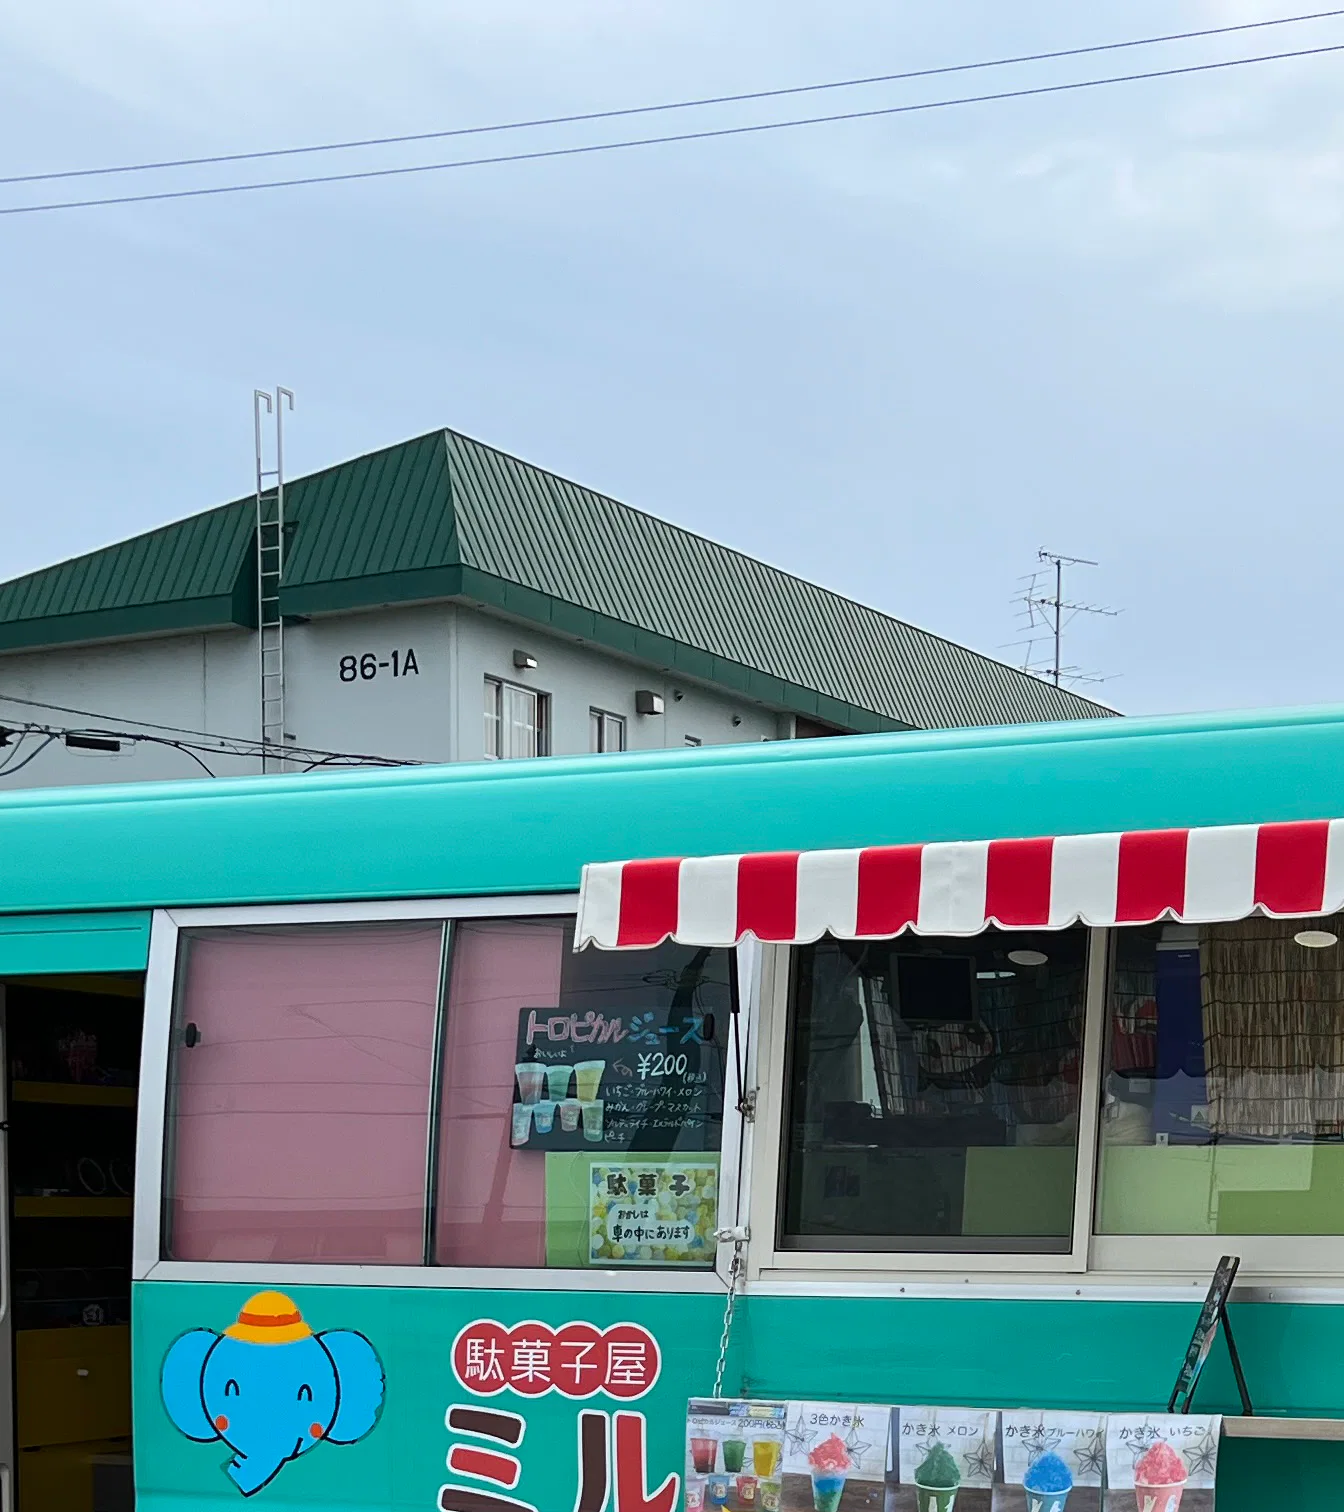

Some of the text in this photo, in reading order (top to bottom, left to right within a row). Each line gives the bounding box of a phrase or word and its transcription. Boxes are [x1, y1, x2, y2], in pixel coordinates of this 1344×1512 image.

[339, 648, 419, 682] 86-1A
[612, 1224, 690, 1243] 車の中にあります
[464, 1337, 648, 1385] 駄菓子屋
[809, 1413, 865, 1428] 3色かき氷
[902, 1422, 979, 1437] かき氷 メロン
[1005, 1424, 1046, 1438] かき氷
[1119, 1426, 1205, 1440] かき氷 いちご
